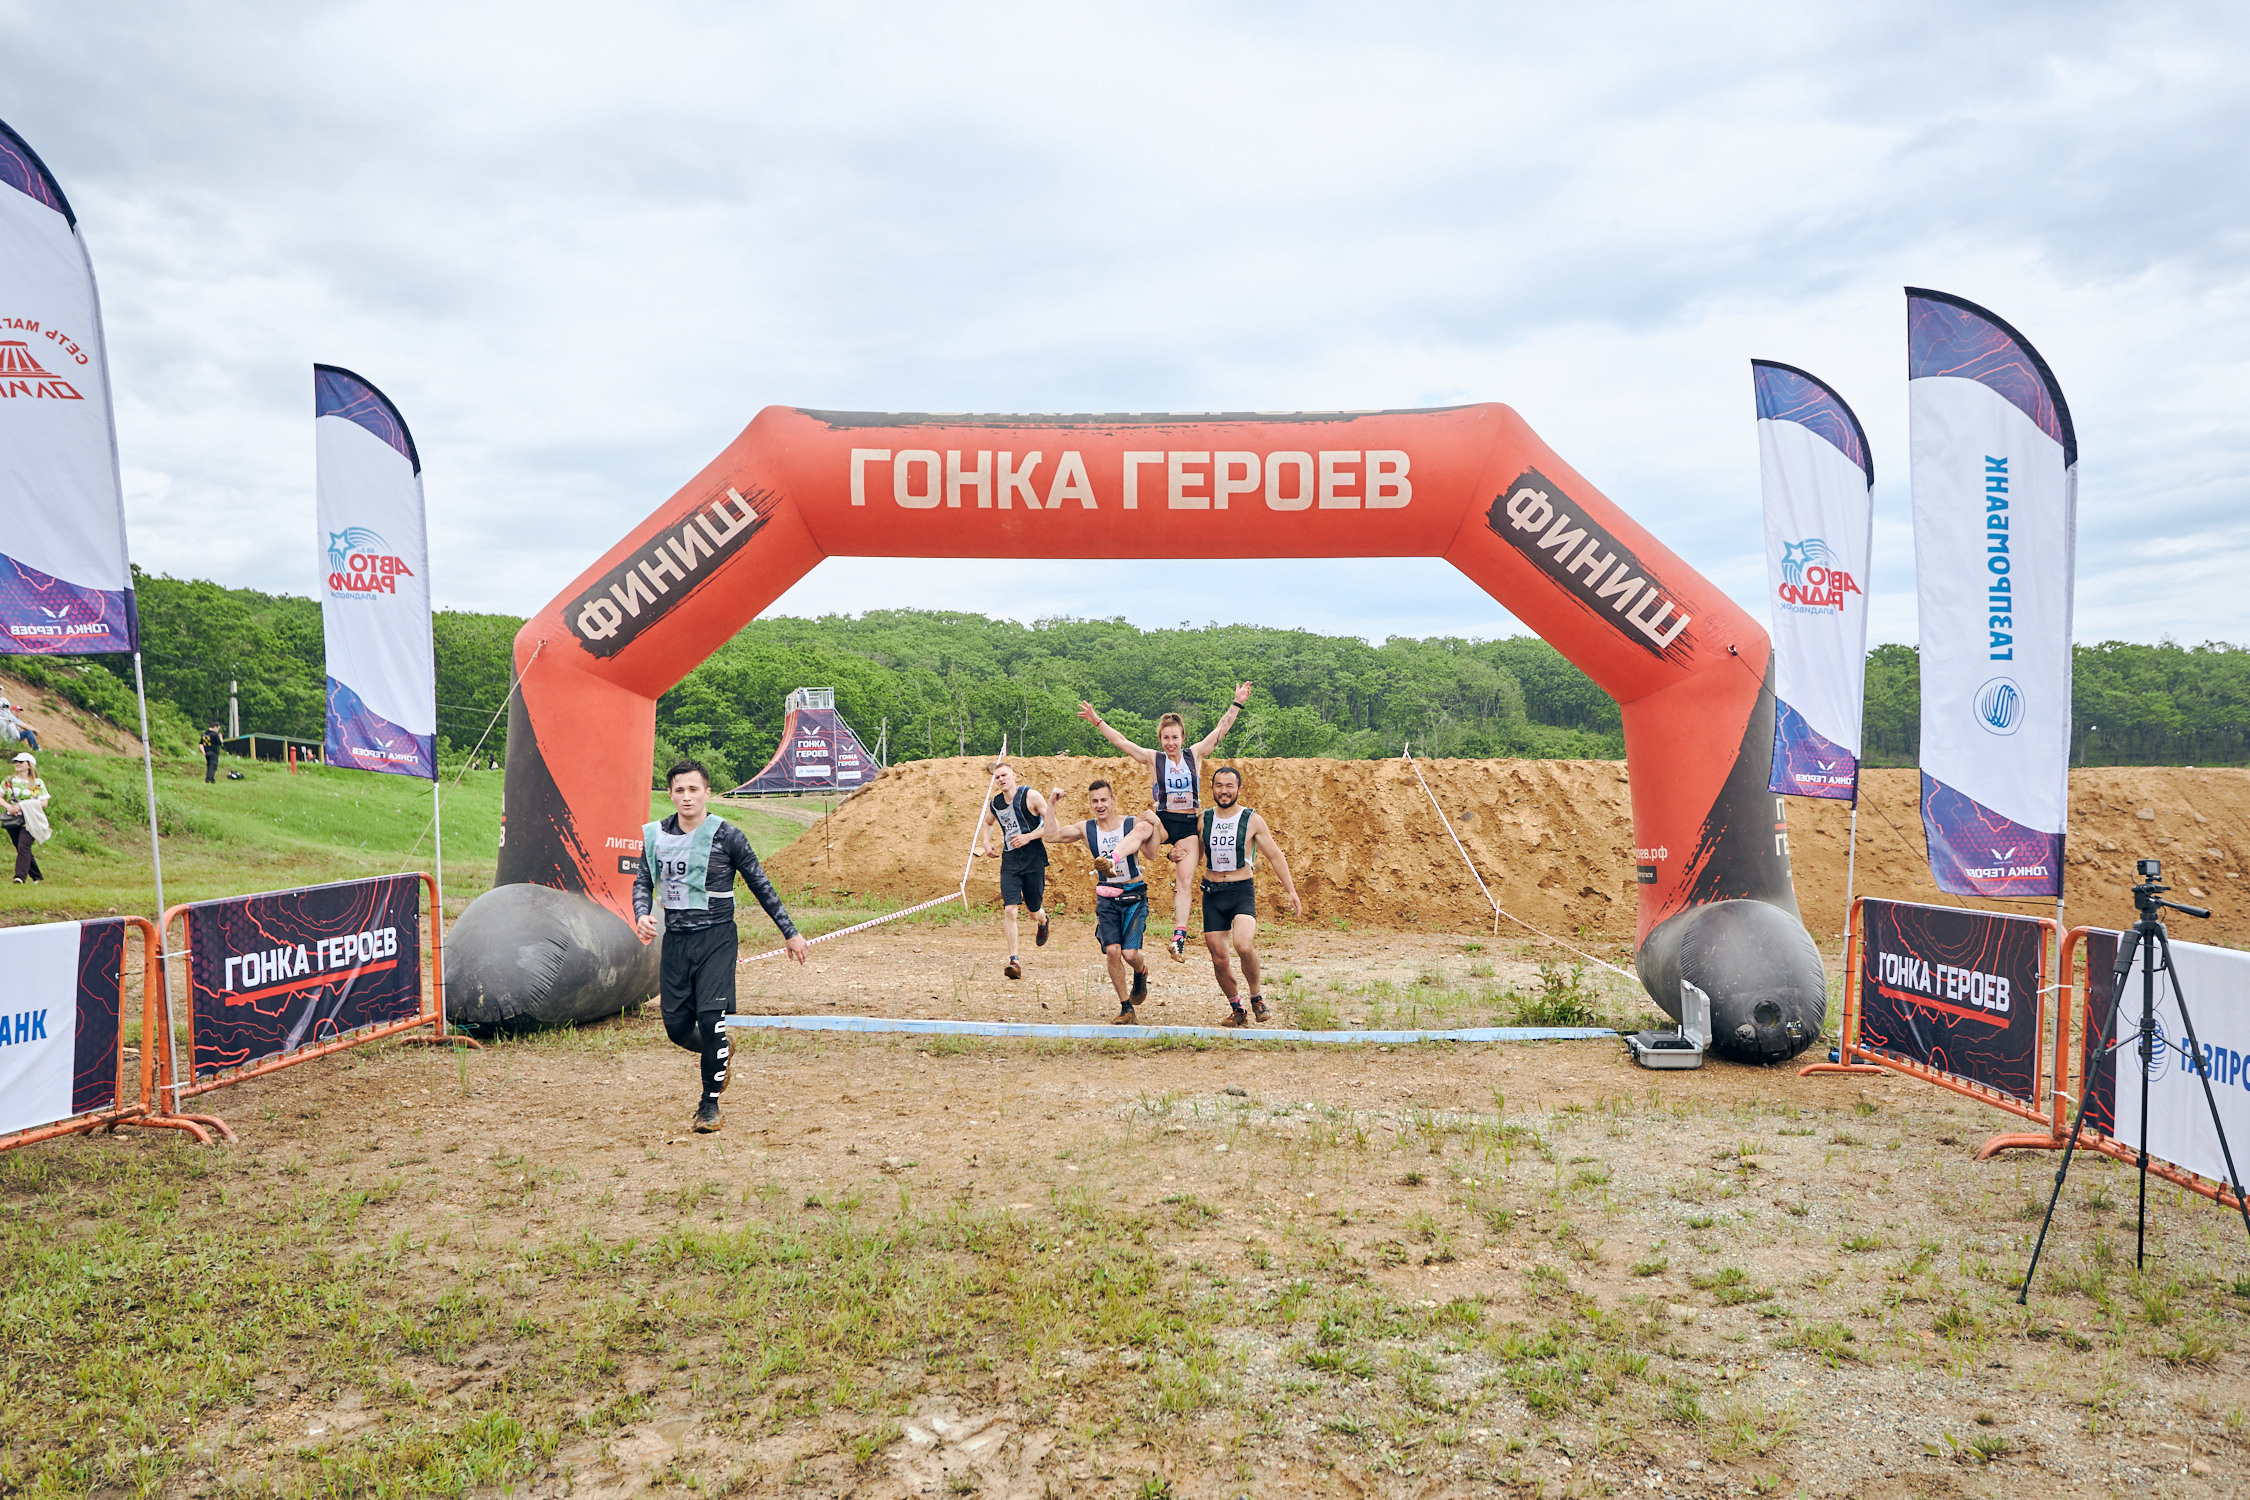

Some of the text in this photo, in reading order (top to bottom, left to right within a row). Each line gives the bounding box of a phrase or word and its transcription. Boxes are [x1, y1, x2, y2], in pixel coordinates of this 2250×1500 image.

[850, 448, 1413, 511] ГОНКА ГЕРОЕВ
[577, 486, 759, 641] ФИНИШ
[1506, 487, 1692, 649] ФИНИШ
[797, 740, 827, 748] ГОНКА
[796, 750, 829, 758] ГЕРОЕВ
[1167, 776, 1189, 789] 101
[605, 836, 644, 851] лигаге
[1102, 835, 1120, 844] AGE
[1211, 836, 1235, 846] 302
[225, 926, 398, 992] ГОНКА ГЕРОЕВ
[1878, 951, 2010, 1013] ГОНКА ГЕРОЕВ
